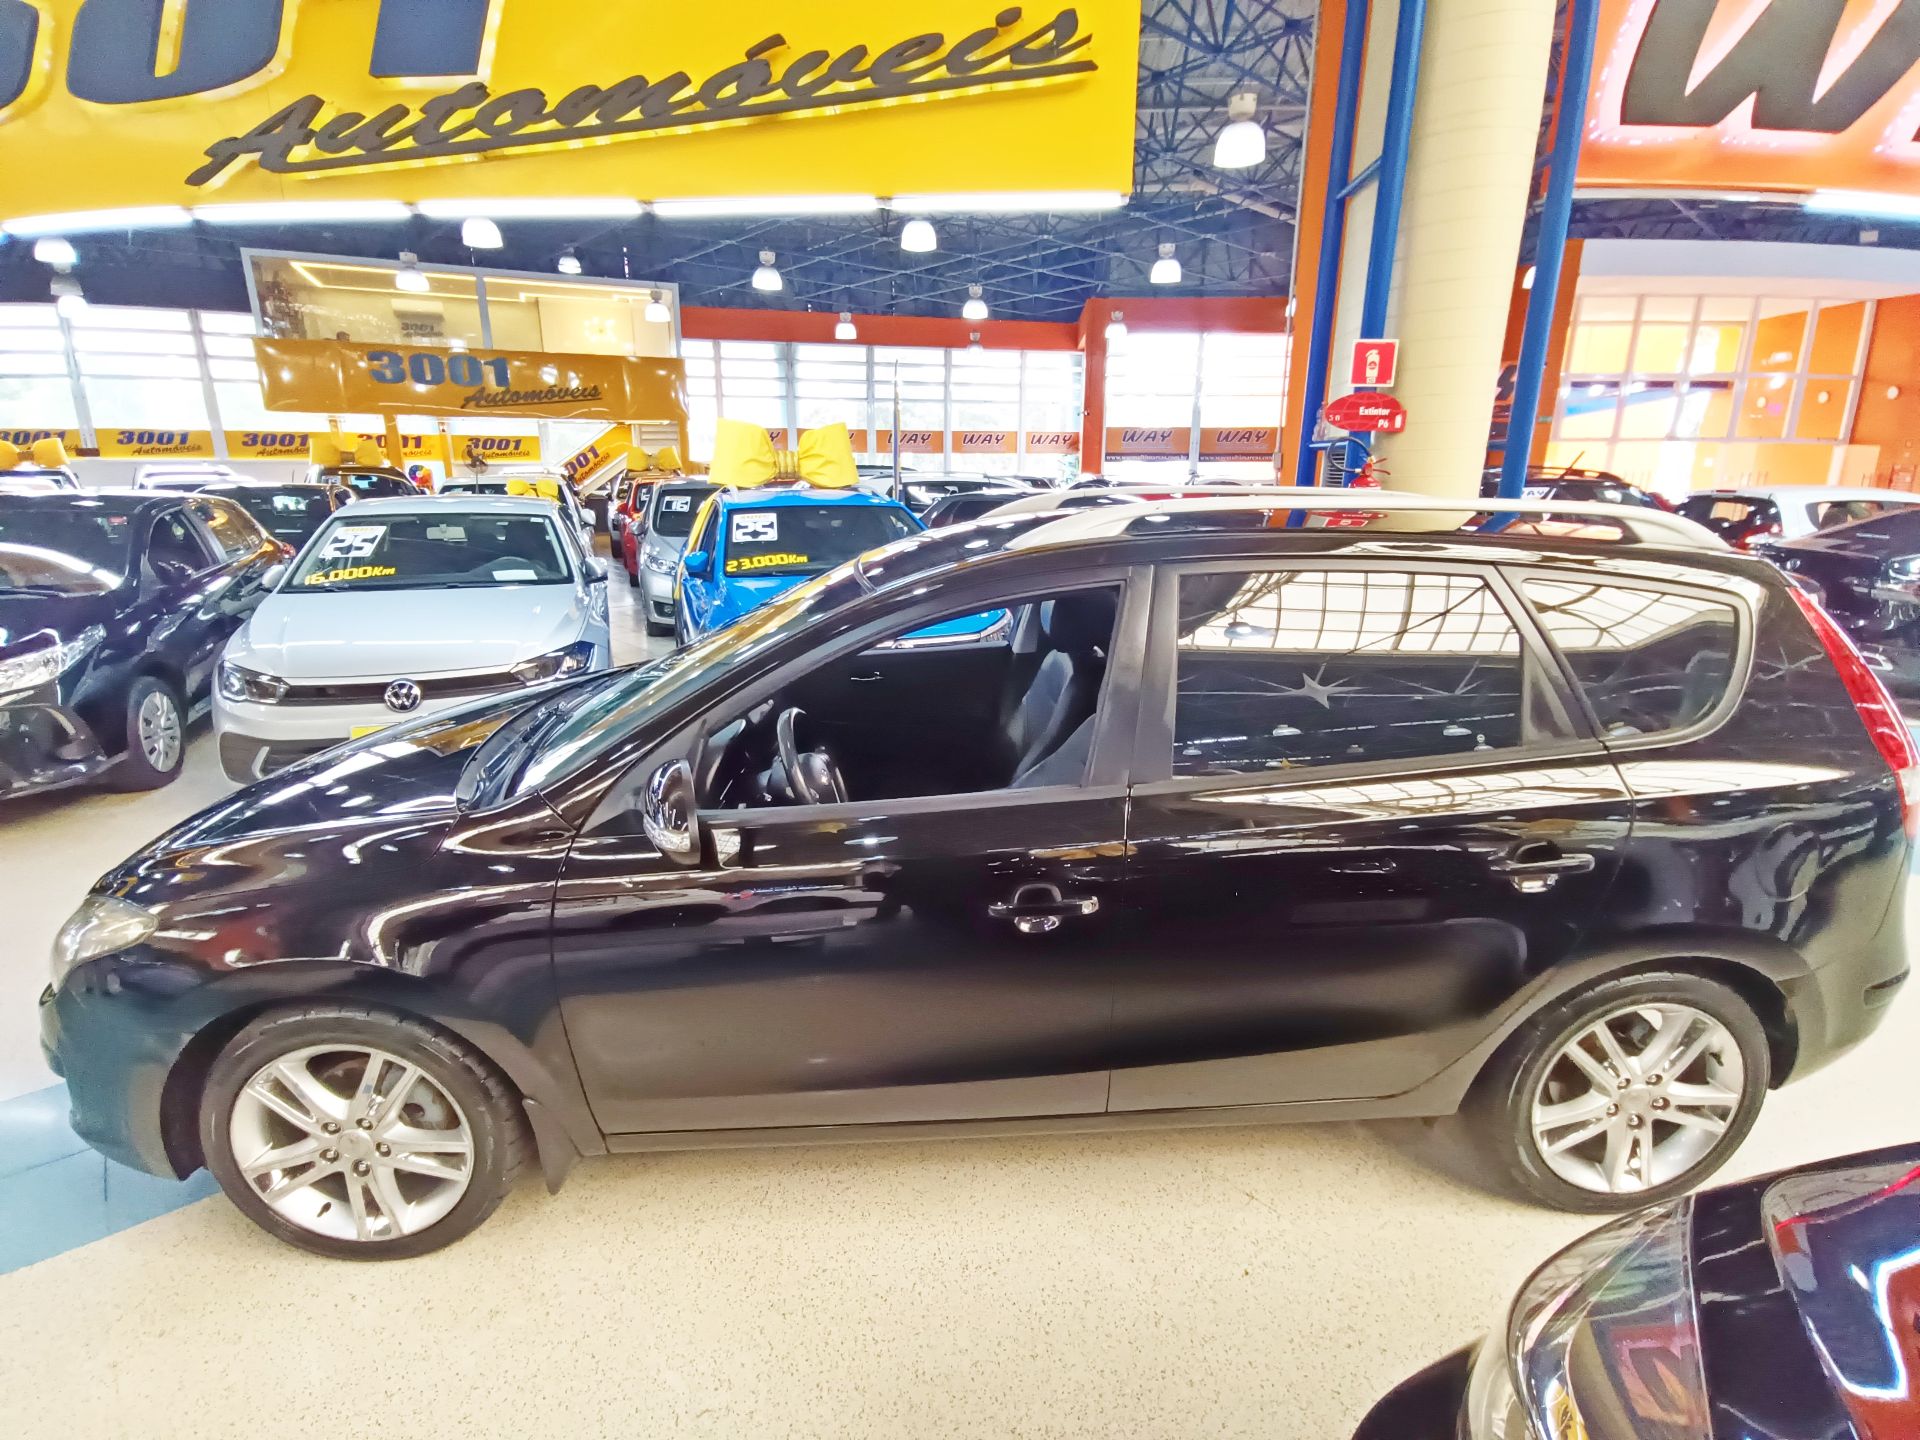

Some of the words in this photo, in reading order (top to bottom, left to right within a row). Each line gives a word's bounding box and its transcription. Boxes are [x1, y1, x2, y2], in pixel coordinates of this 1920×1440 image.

[1622, 0, 1920, 142] W
[185, 7, 1098, 186] Automóveis
[367, 351, 510, 388] 3001
[461, 385, 603, 409] Automóveis
[1359, 406, 1391, 416] Extintor
[1377, 419, 1390, 429] P6
[117, 431, 189, 445] 3001
[241, 433, 309, 447] 3001
[963, 433, 1006, 445] WAY
[1030, 434, 1072, 445] WAY
[1122, 430, 1173, 442] WAY
[1216, 430, 1268, 442] WAY
[468, 437, 523, 451] 3001
[564, 445, 600, 476] 001
[735, 520, 776, 541] 25
[321, 533, 380, 556] 25
[304, 566, 397, 586] 16.000Km
